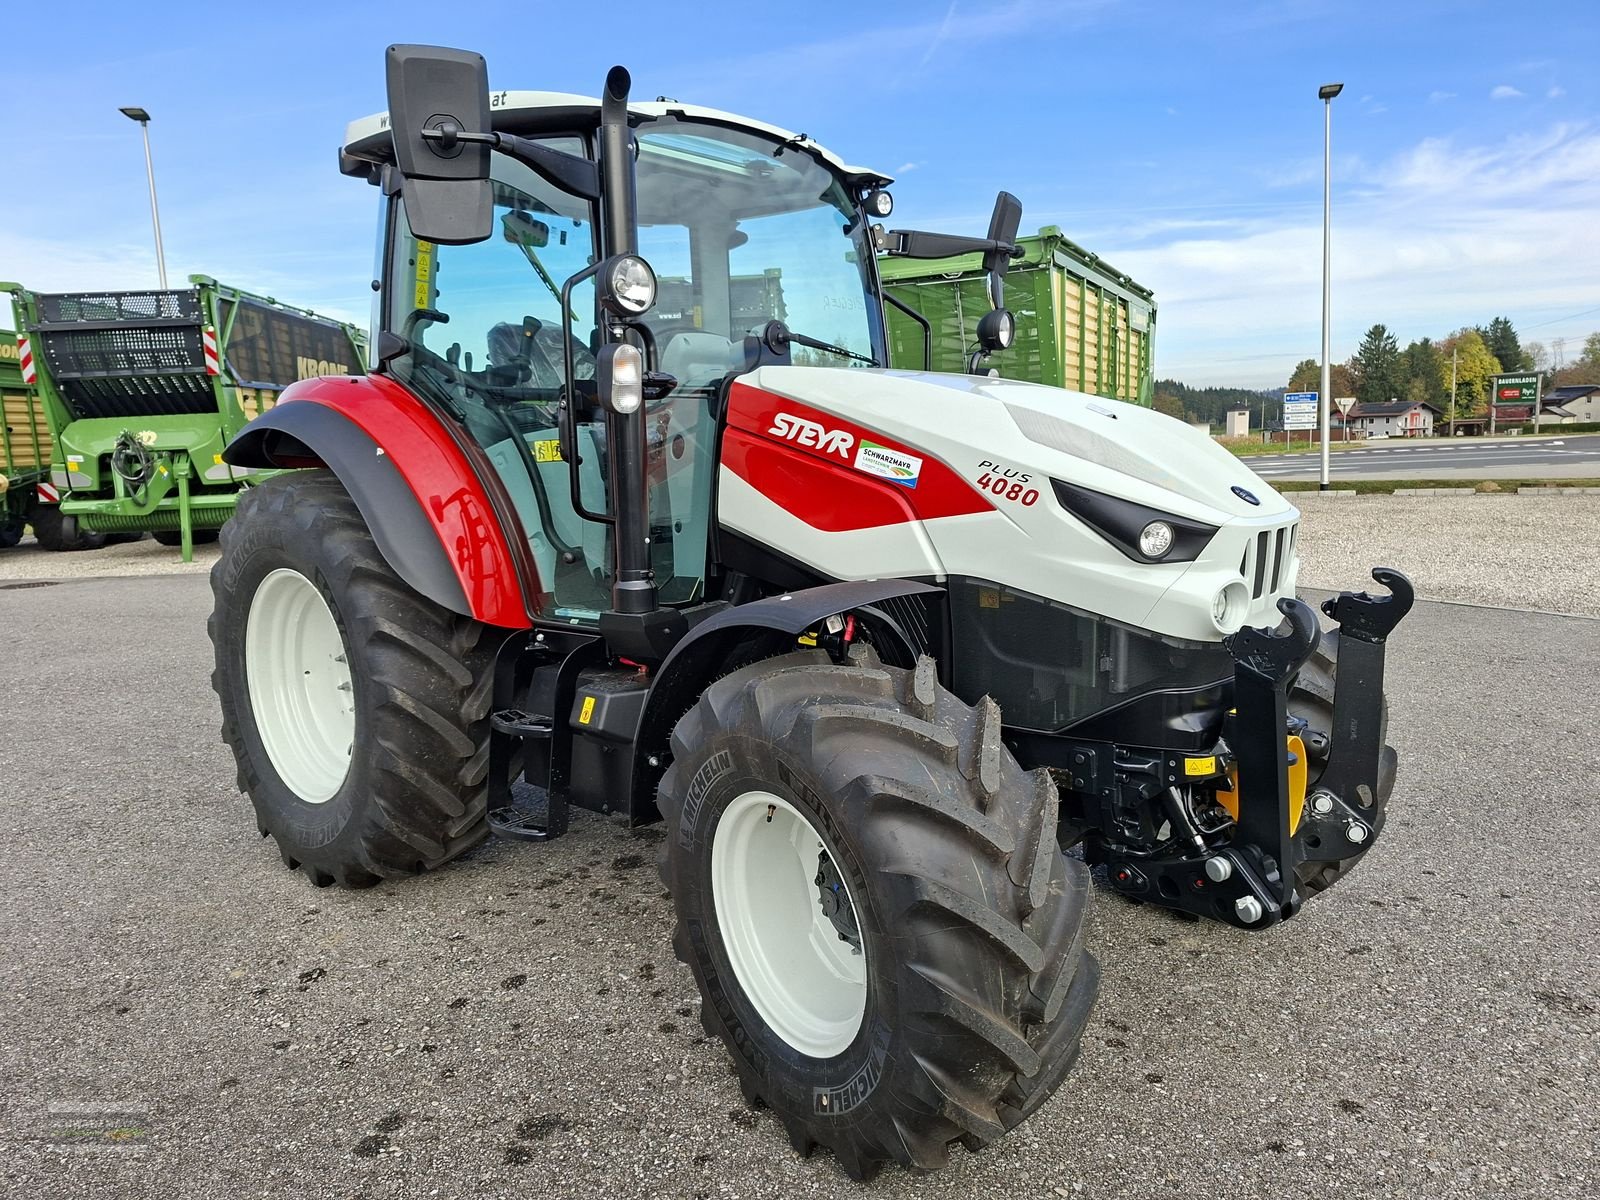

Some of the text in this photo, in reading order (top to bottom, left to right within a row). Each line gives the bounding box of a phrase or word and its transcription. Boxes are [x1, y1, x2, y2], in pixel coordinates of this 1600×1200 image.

[1498, 377, 1537, 385] BAUERNLADEN
[768, 412, 854, 459] STEYR
[863, 448, 912, 470] SCHWARZMAYR
[977, 460, 1033, 483] PLUS
[976, 472, 1040, 507] 4080
[683, 750, 731, 827] MICHELIN
[815, 1049, 884, 1113] MICHELIN
